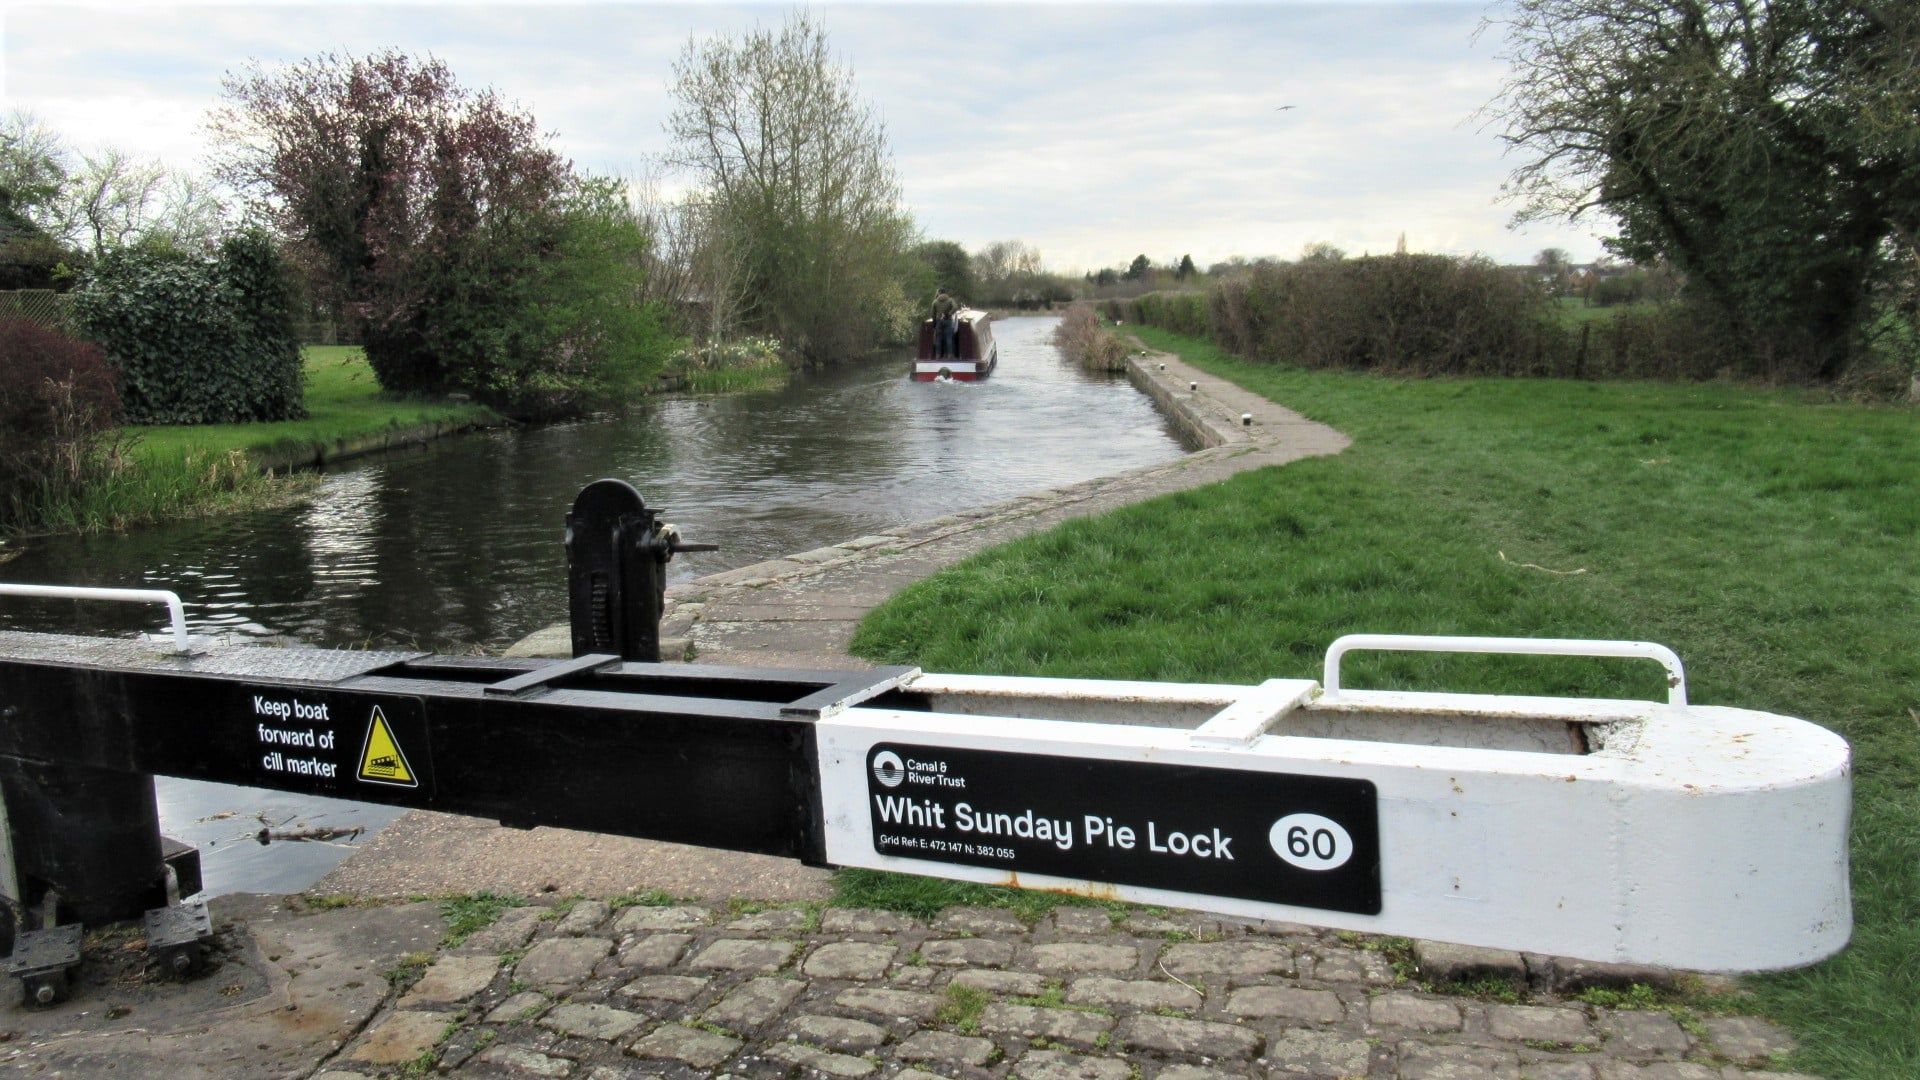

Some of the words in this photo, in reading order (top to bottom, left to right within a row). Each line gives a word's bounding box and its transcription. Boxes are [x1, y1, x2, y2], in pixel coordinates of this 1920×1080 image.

[254, 695, 291, 721] Keep
[294, 698, 330, 721] boat
[258, 723, 315, 747] forward
[319, 730, 335, 749] of
[263, 752, 284, 771] cill
[286, 757, 337, 778] marker
[906, 758, 938, 772] Canal
[939, 761, 947, 772] &
[908, 773, 936, 784] River
[937, 774, 966, 788] Trust
[875, 794, 946, 829] Whit
[954, 802, 1073, 850] Sunday
[1084, 815, 1136, 850] Pie
[1148, 821, 1235, 860] Lock
[880, 834, 900, 845] Grid
[901, 836, 918, 848] Ref:
[920, 838, 928, 848] E:
[929, 840, 946, 850] 472
[947, 842, 963, 852] 147
[964, 844, 975, 854] N:
[976, 846, 995, 857] 382
[996, 847, 1015, 859] 055
[1287, 826, 1336, 860] 60
